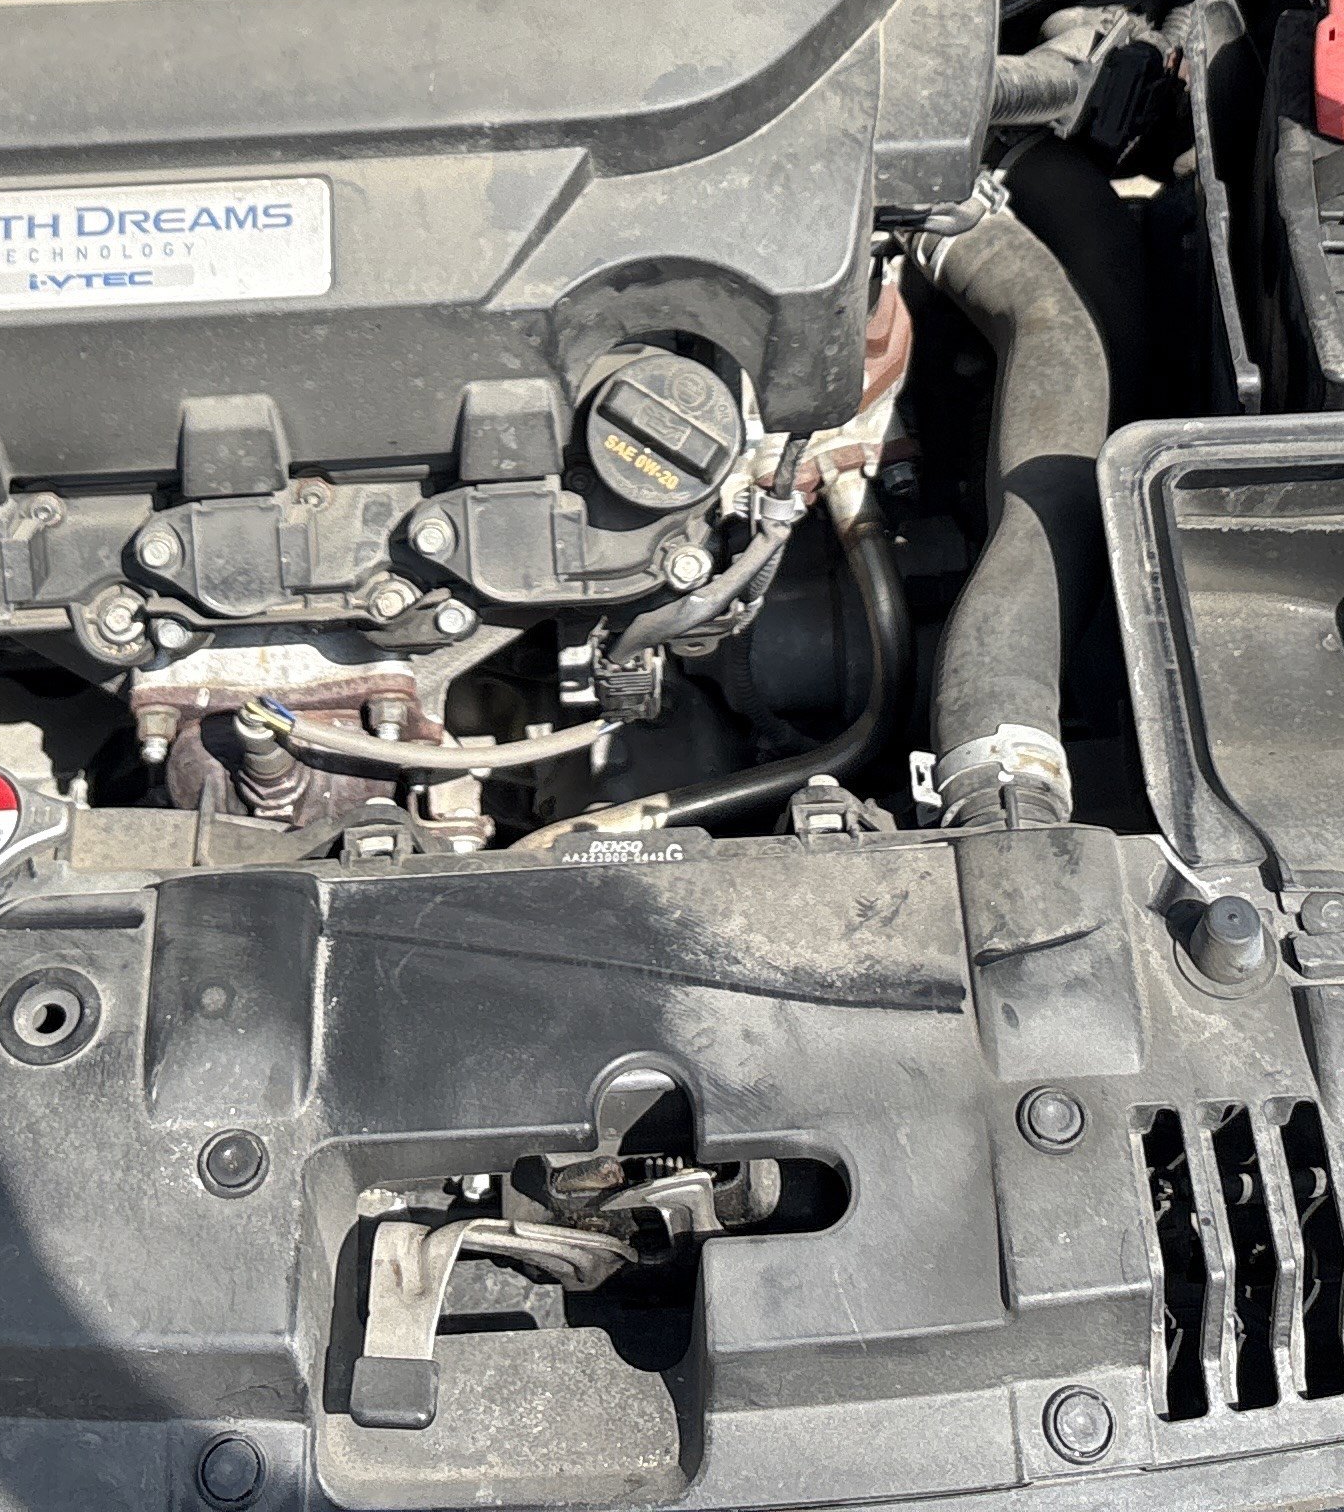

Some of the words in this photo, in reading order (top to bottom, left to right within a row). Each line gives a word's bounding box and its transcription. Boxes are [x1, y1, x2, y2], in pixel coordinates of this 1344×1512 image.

[76, 203, 294, 237] DREAMS
[604, 434, 638, 463] SAE
[634, 454, 680, 490] 0W-20
[589, 840, 644, 853] DENSO
